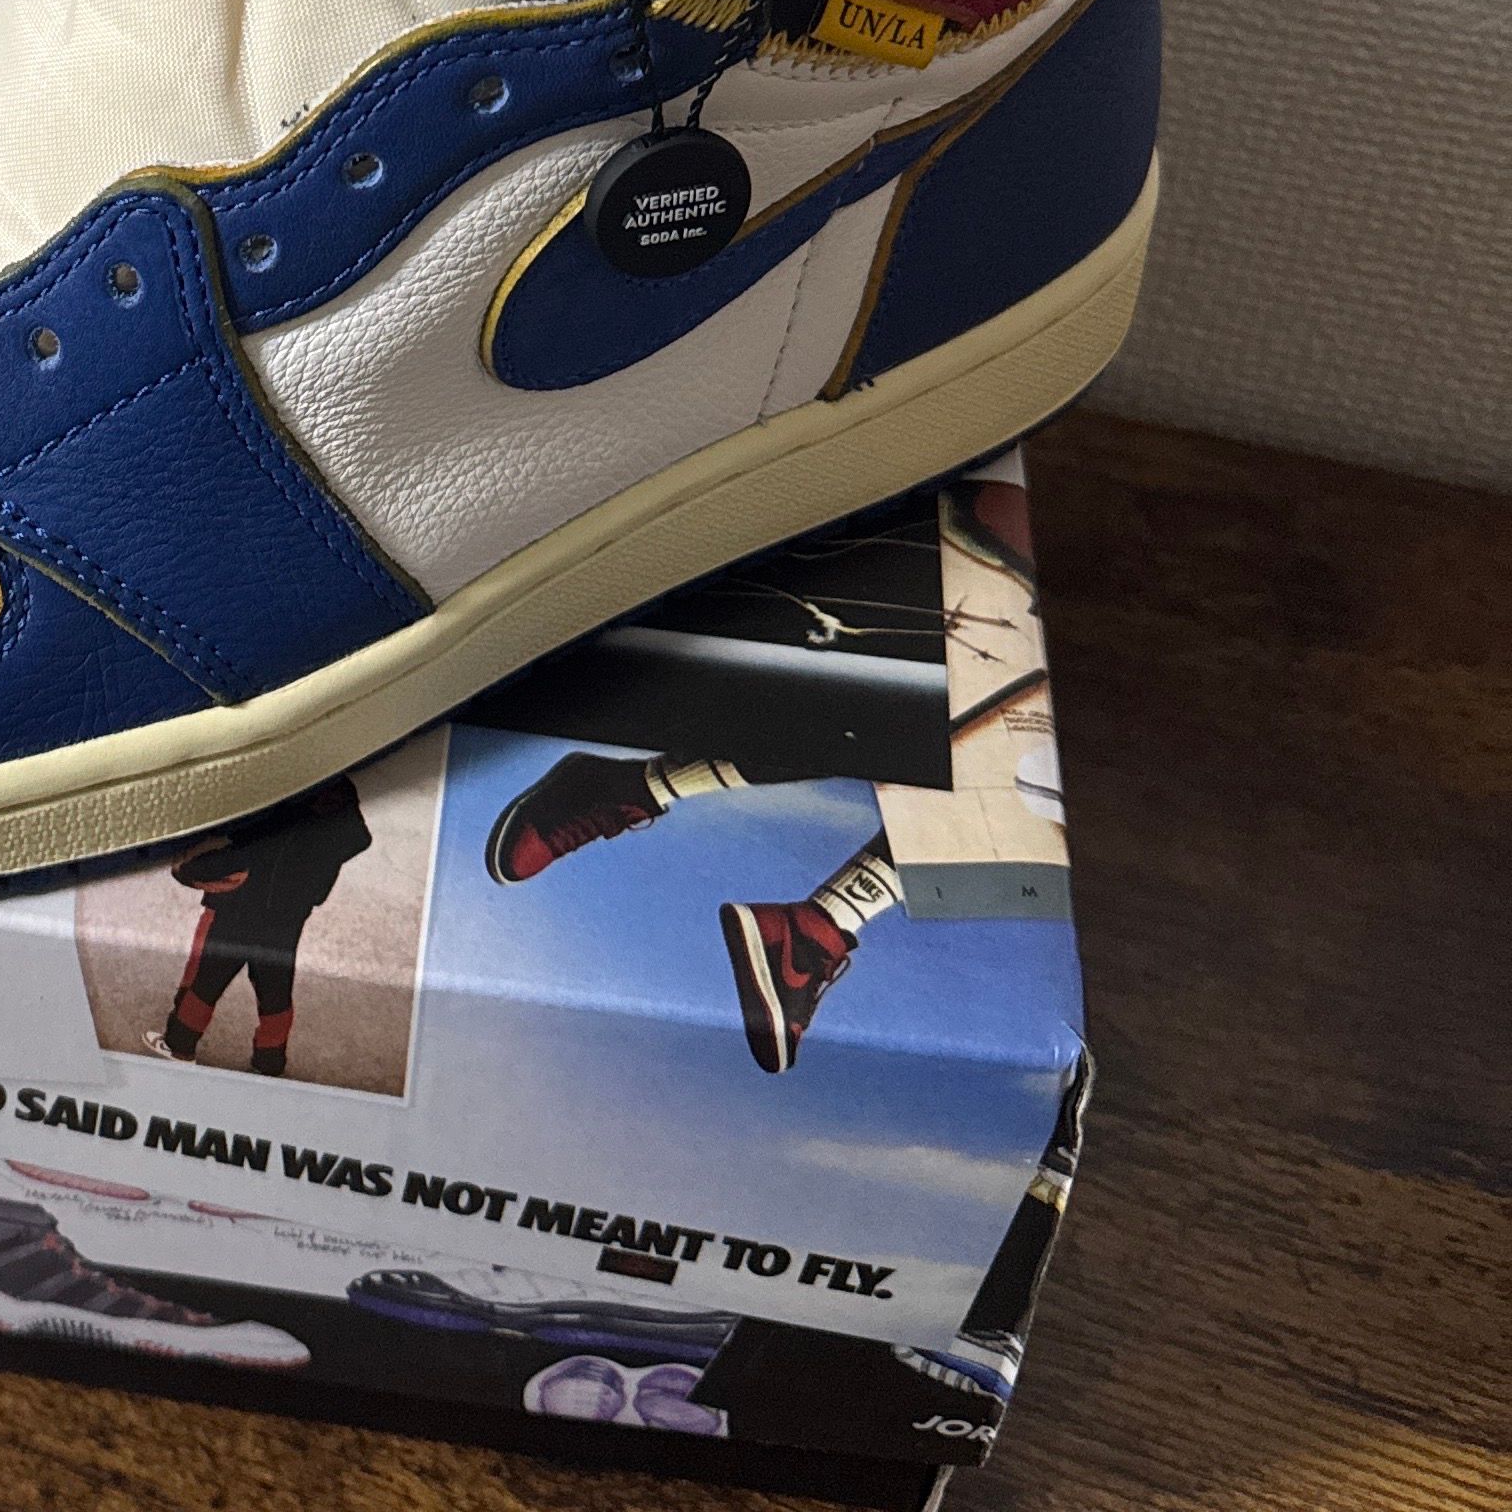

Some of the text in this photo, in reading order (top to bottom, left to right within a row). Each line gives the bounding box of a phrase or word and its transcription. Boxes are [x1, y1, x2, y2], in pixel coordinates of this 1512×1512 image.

[633, 185, 720, 211] VERIFIED
[623, 199, 728, 230] AUTHENTIC
[639, 226, 708, 246] SODA Inc.
[854, 870, 884, 902] NIKE
[14, 1087, 139, 1141] SAID
[143, 1115, 272, 1172] MAN
[280, 1143, 394, 1197] WAS
[401, 1170, 518, 1223] NOT
[517, 1196, 715, 1263] MEANT
[722, 1234, 792, 1278] TO
[797, 1252, 895, 1300] FLY.
